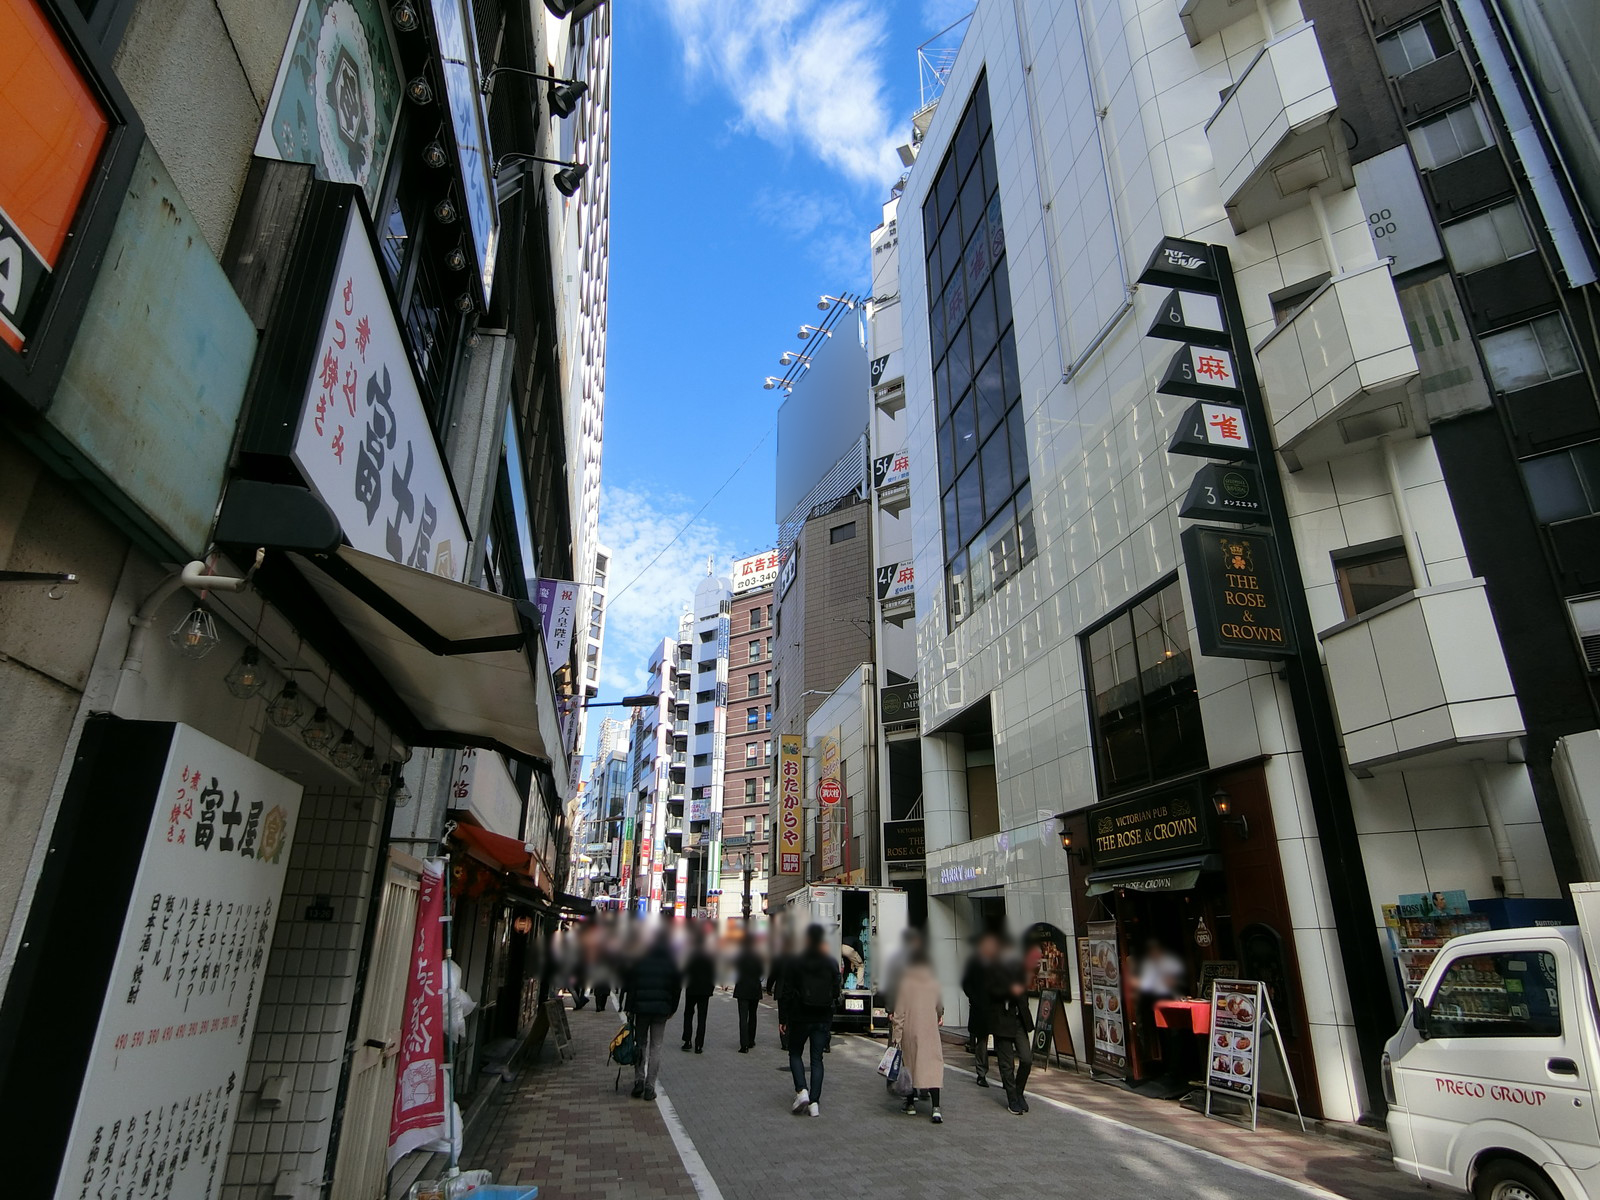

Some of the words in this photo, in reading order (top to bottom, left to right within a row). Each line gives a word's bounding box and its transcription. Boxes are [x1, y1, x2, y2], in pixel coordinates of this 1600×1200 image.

[1169, 306, 1182, 323] 6
[1182, 363, 1192, 380] 5
[1197, 355, 1230, 381] 麻
[1193, 423, 1204, 440] 4
[1210, 413, 1242, 441] 雀
[1204, 486, 1217, 505] 3
[1223, 499, 1259, 509] メンズエステ
[742, 552, 787, 577] 広告主
[897, 567, 914, 585] 麻
[1225, 573, 1259, 590] THE
[561, 590, 573, 601] 祝
[1224, 590, 1267, 608] ROSE
[1243, 610, 1255, 623] &
[554, 606, 571, 650] 天皇陛下
[1221, 623, 1282, 642] CROWN
[822, 789, 840, 798] 消火栓
[783, 760, 799, 846] おたからや
[194, 776, 264, 859] 富士屋
[1115, 810, 1151, 828] VICTORIAN
[1152, 806, 1168, 818] PUB
[1096, 834, 1116, 852] THE
[1117, 829, 1142, 848] ROSE
[1144, 828, 1152, 842] &
[1153, 817, 1197, 841] CROWN
[783, 854, 799, 863] 買取
[887, 847, 908, 857] ROSE
[783, 863, 799, 872] 専門
[1145, 878, 1171, 889] CROWN
[1401, 903, 1420, 913] BOSS
[1197, 934, 1210, 943] OPEN
[1435, 1078, 1485, 1098] PRECO
[1490, 1085, 1546, 1106] GROUP
